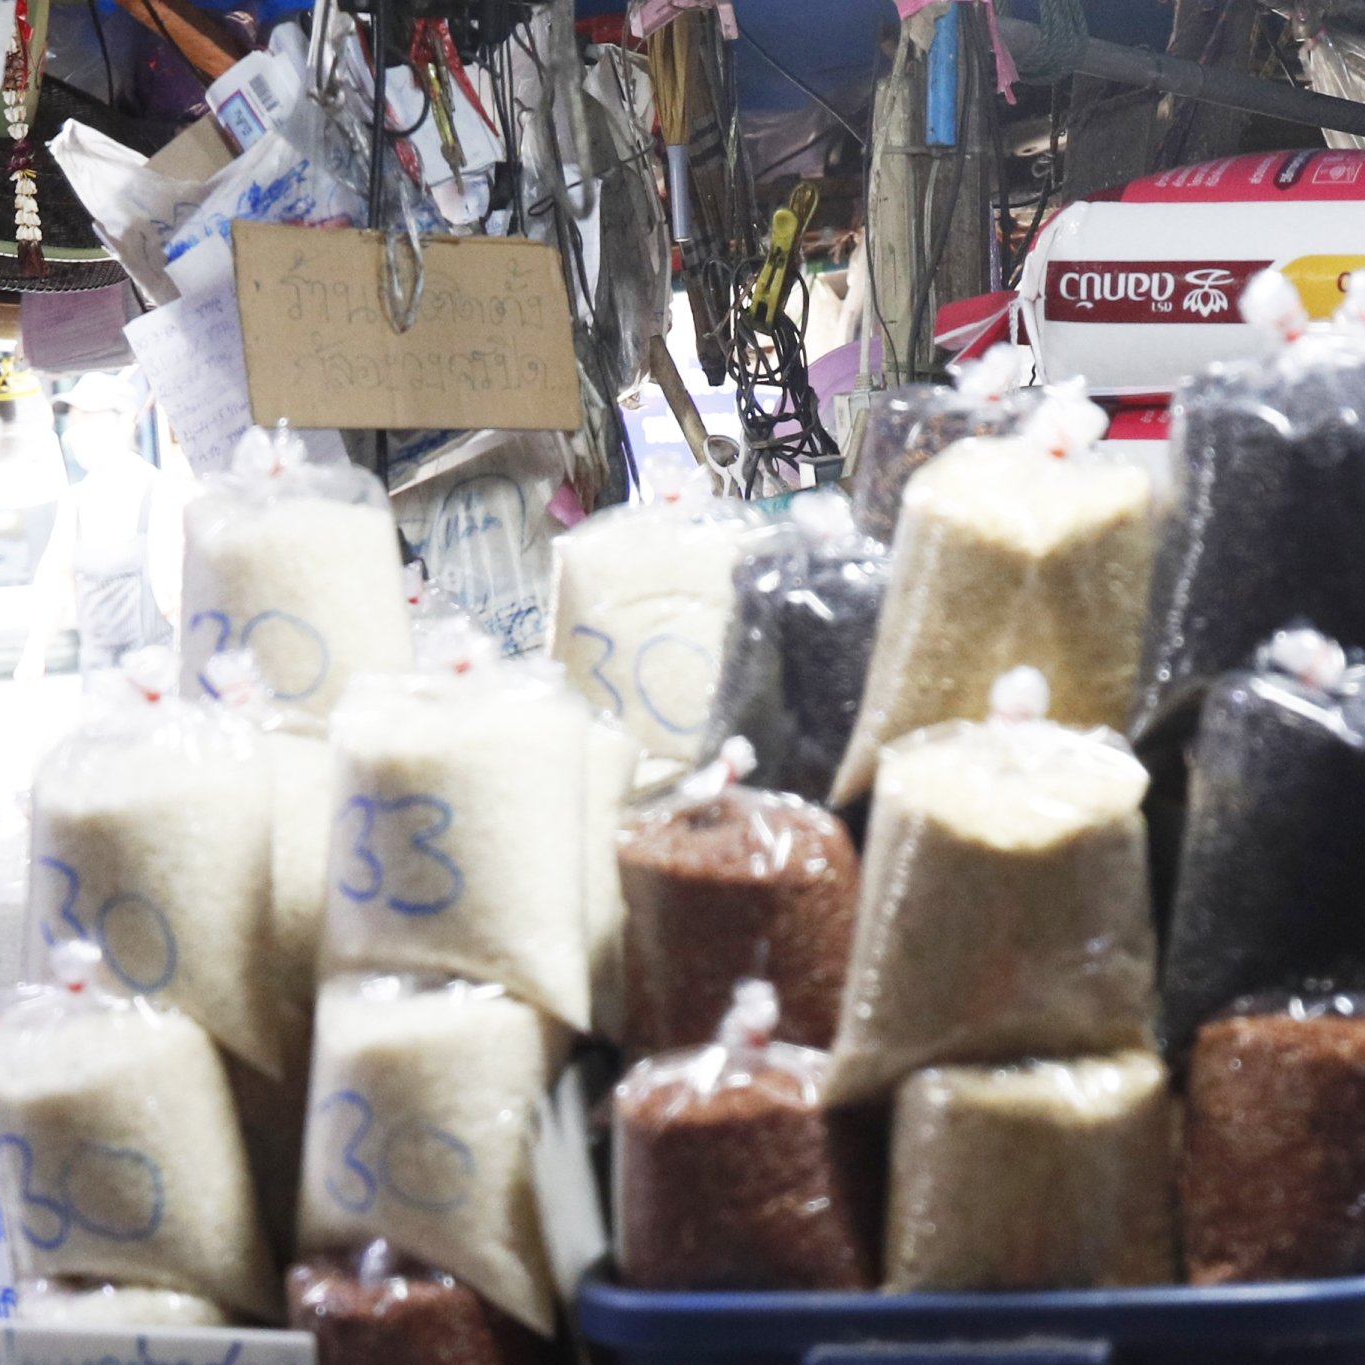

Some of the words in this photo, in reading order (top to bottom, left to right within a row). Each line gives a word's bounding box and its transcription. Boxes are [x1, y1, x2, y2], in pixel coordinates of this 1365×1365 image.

[1059, 272, 1176, 310] ดอกบัว
[1150, 301, 1174, 312] ตรา
[571, 624, 719, 740] 30
[336, 792, 464, 916] 33
[315, 1090, 477, 1214] 30
